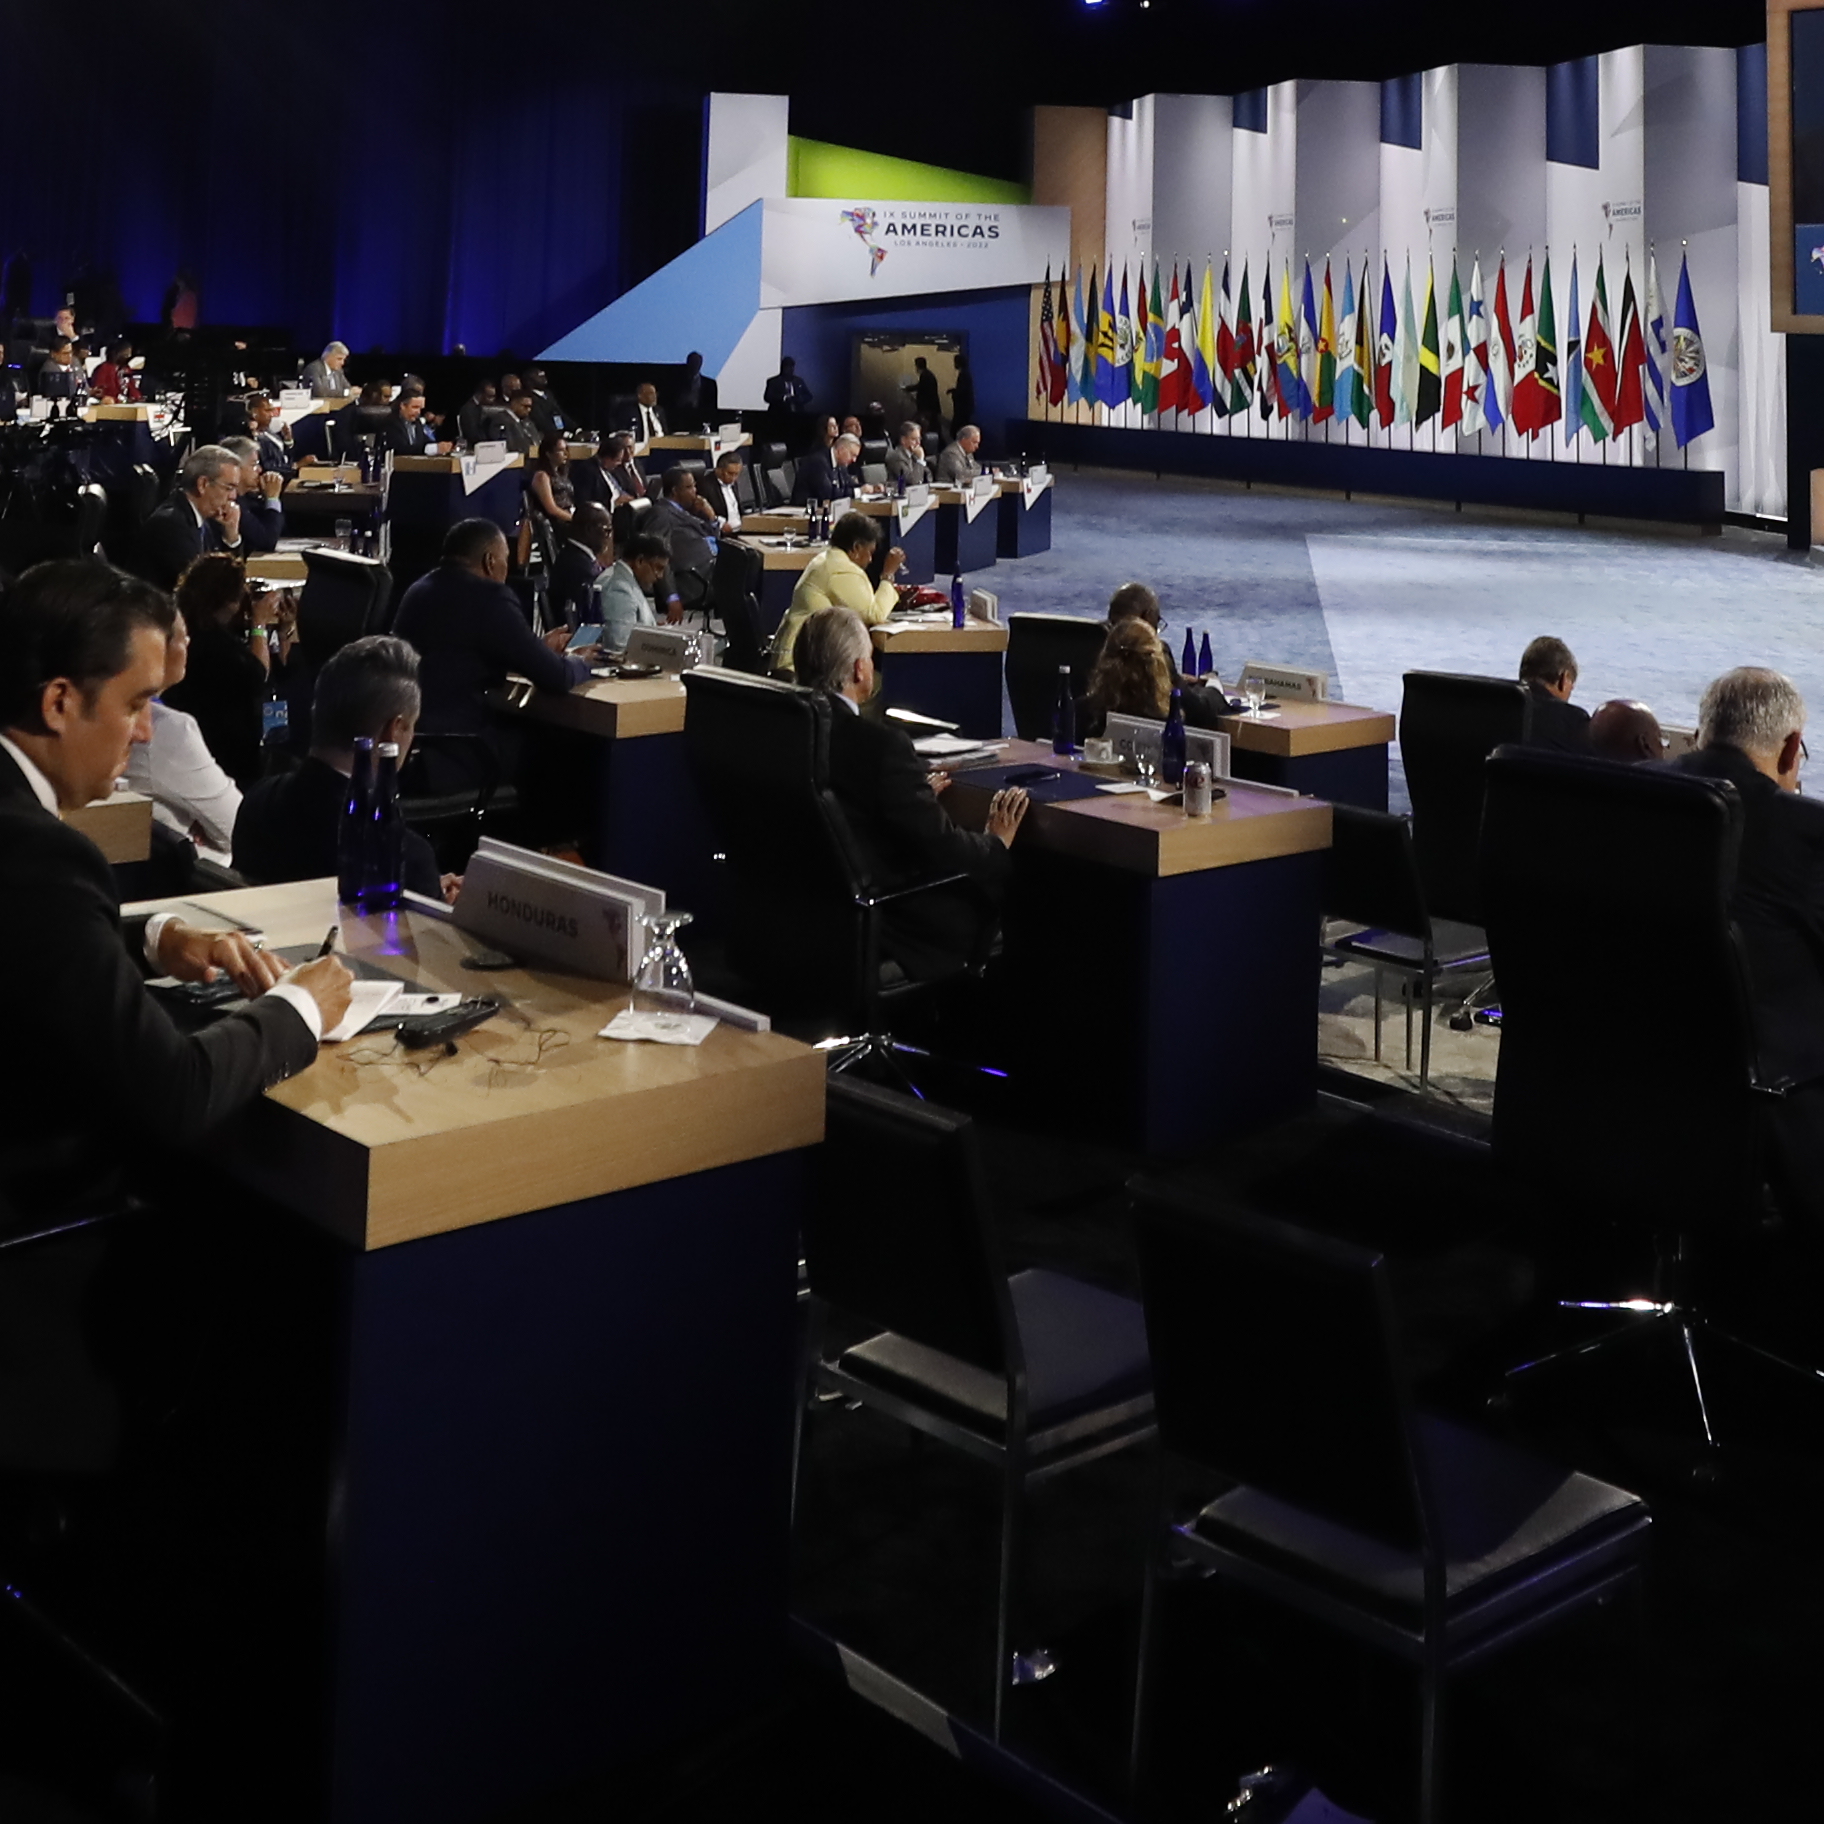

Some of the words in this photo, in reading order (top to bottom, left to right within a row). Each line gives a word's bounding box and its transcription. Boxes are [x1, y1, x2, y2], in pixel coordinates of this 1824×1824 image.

[901, 211, 951, 220] SUMMIT
[955, 213, 972, 221] OF
[977, 213, 1001, 222] THE
[1612, 206, 1642, 216] AMERICAS
[885, 222, 1001, 240] AMERICAS
[487, 890, 579, 939] HONDURAS
